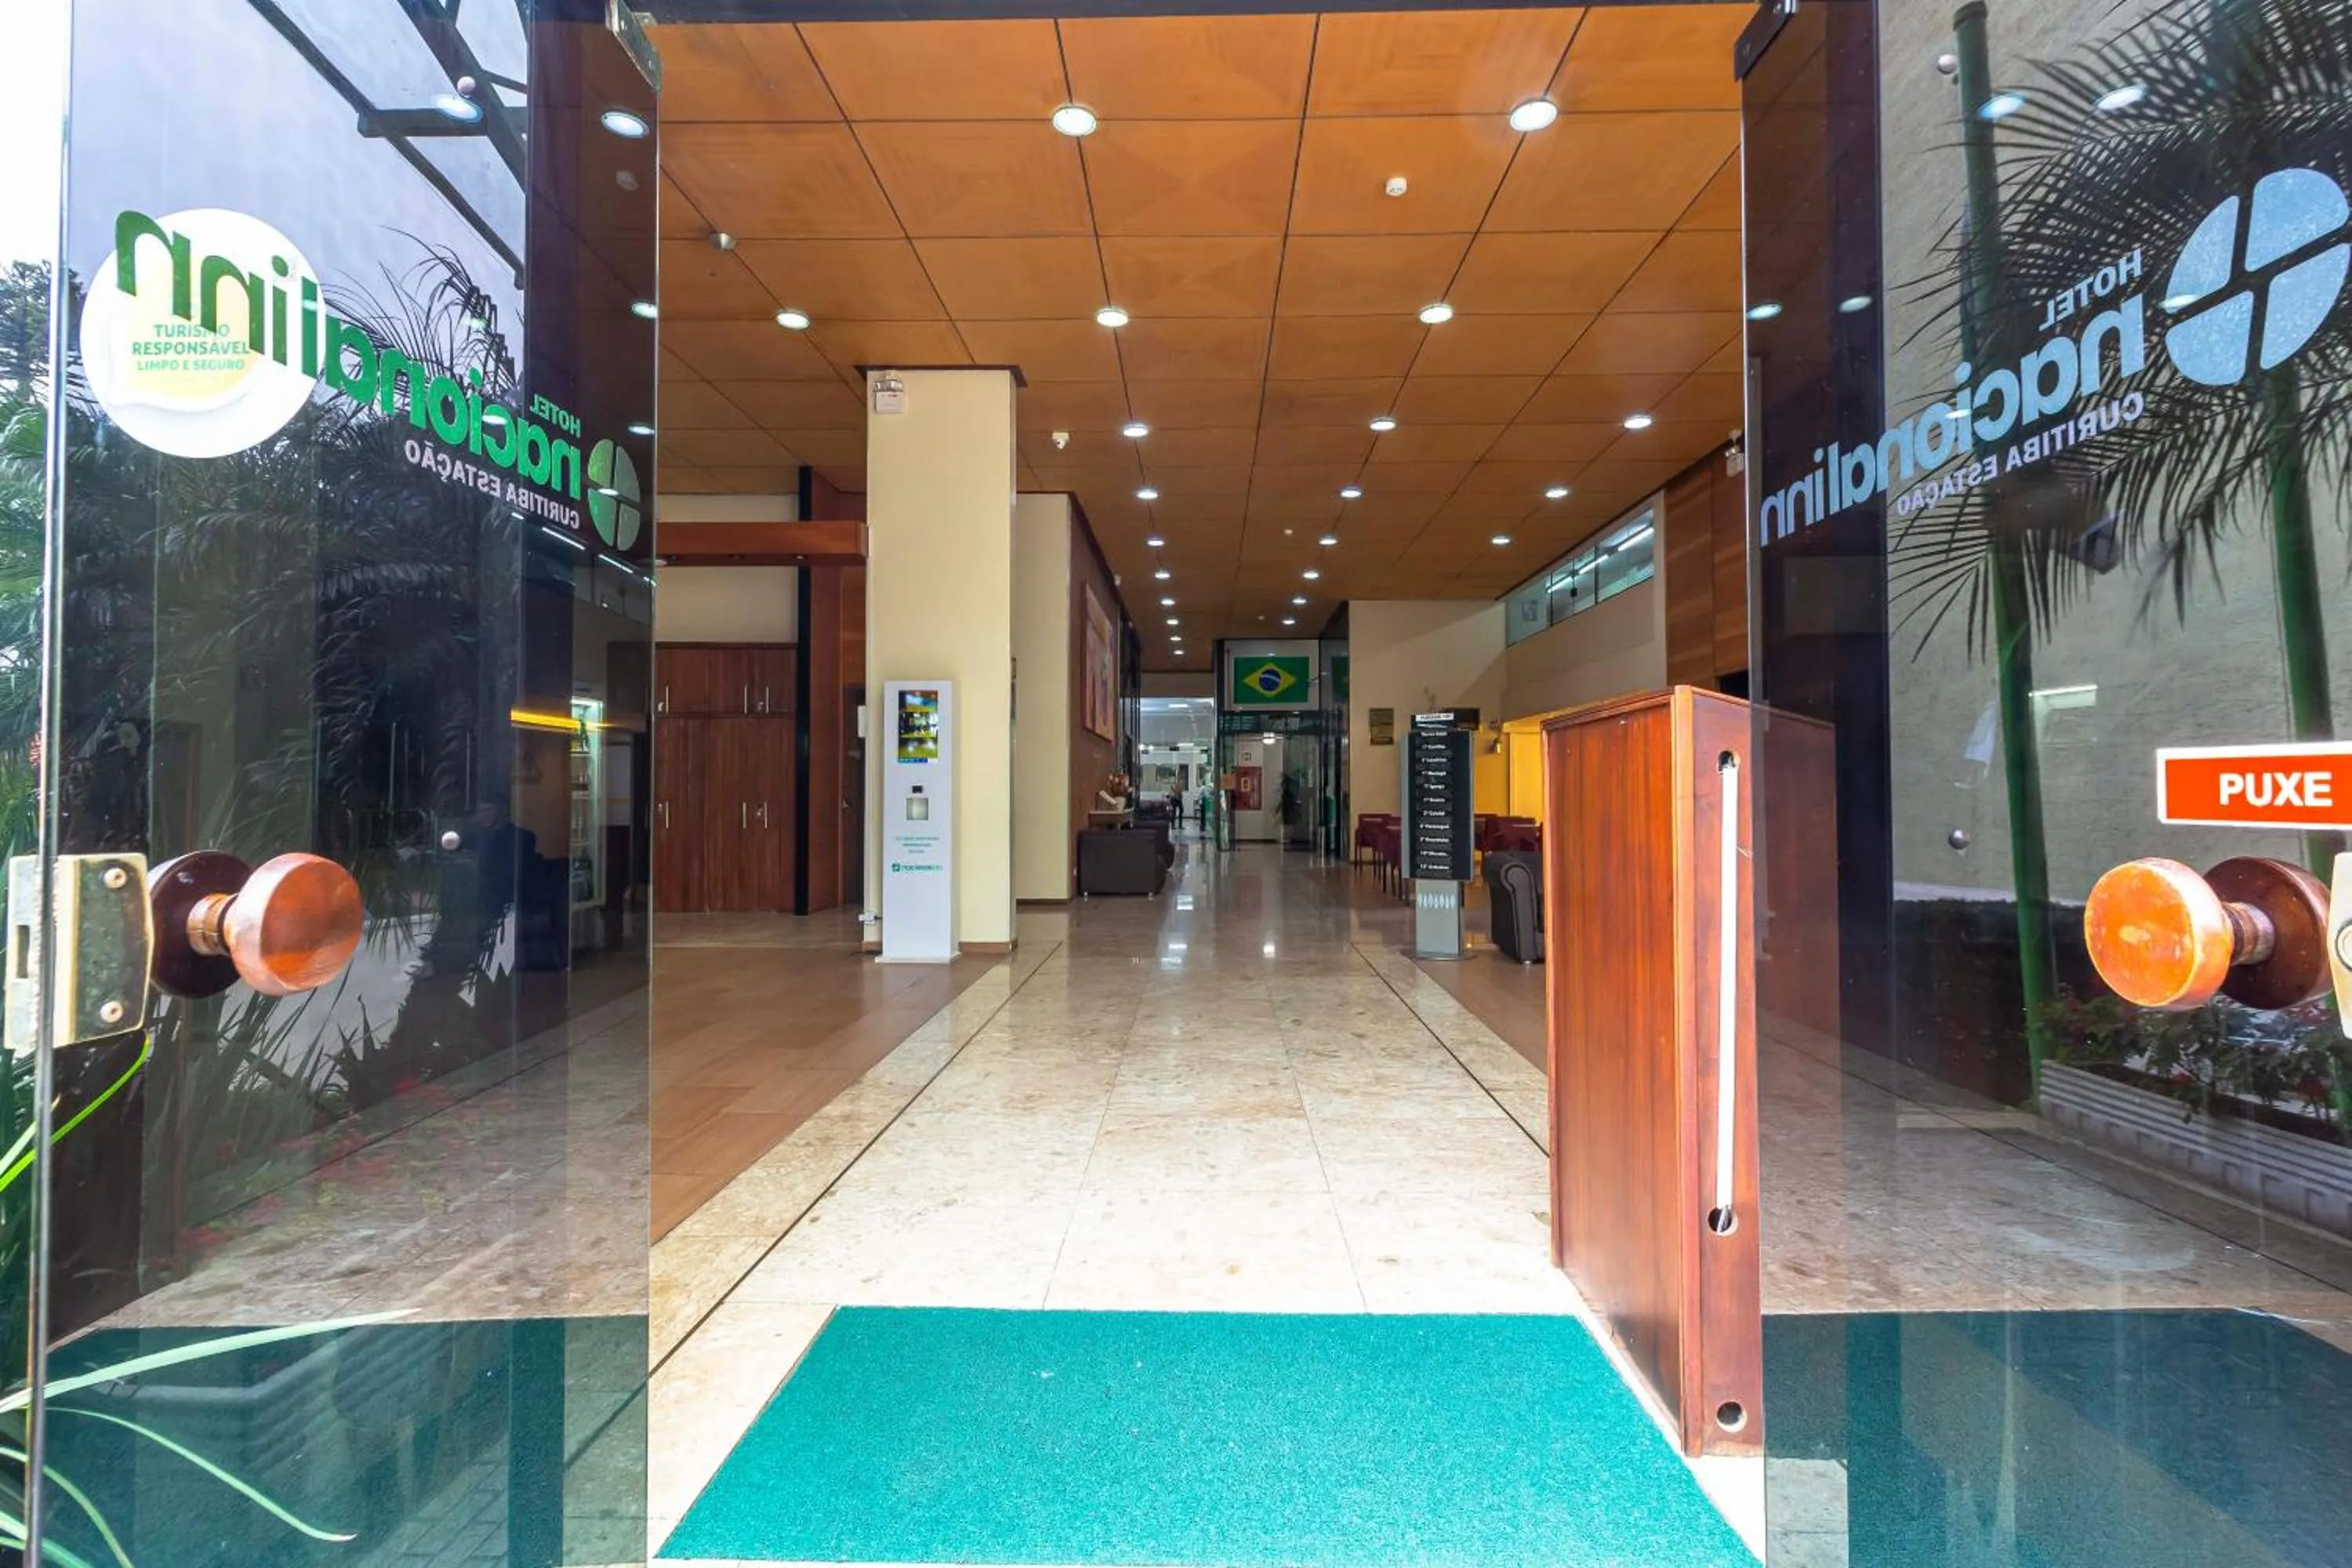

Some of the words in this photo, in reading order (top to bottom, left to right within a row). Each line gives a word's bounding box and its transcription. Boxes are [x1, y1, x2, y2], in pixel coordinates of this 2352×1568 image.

[132, 339, 250, 355] RESPONSÁVEL
[137, 359, 180, 371] LIMPO
[182, 359, 190, 371] E
[193, 359, 245, 371] SEGURO
[2220, 771, 2333, 807] PUXE
